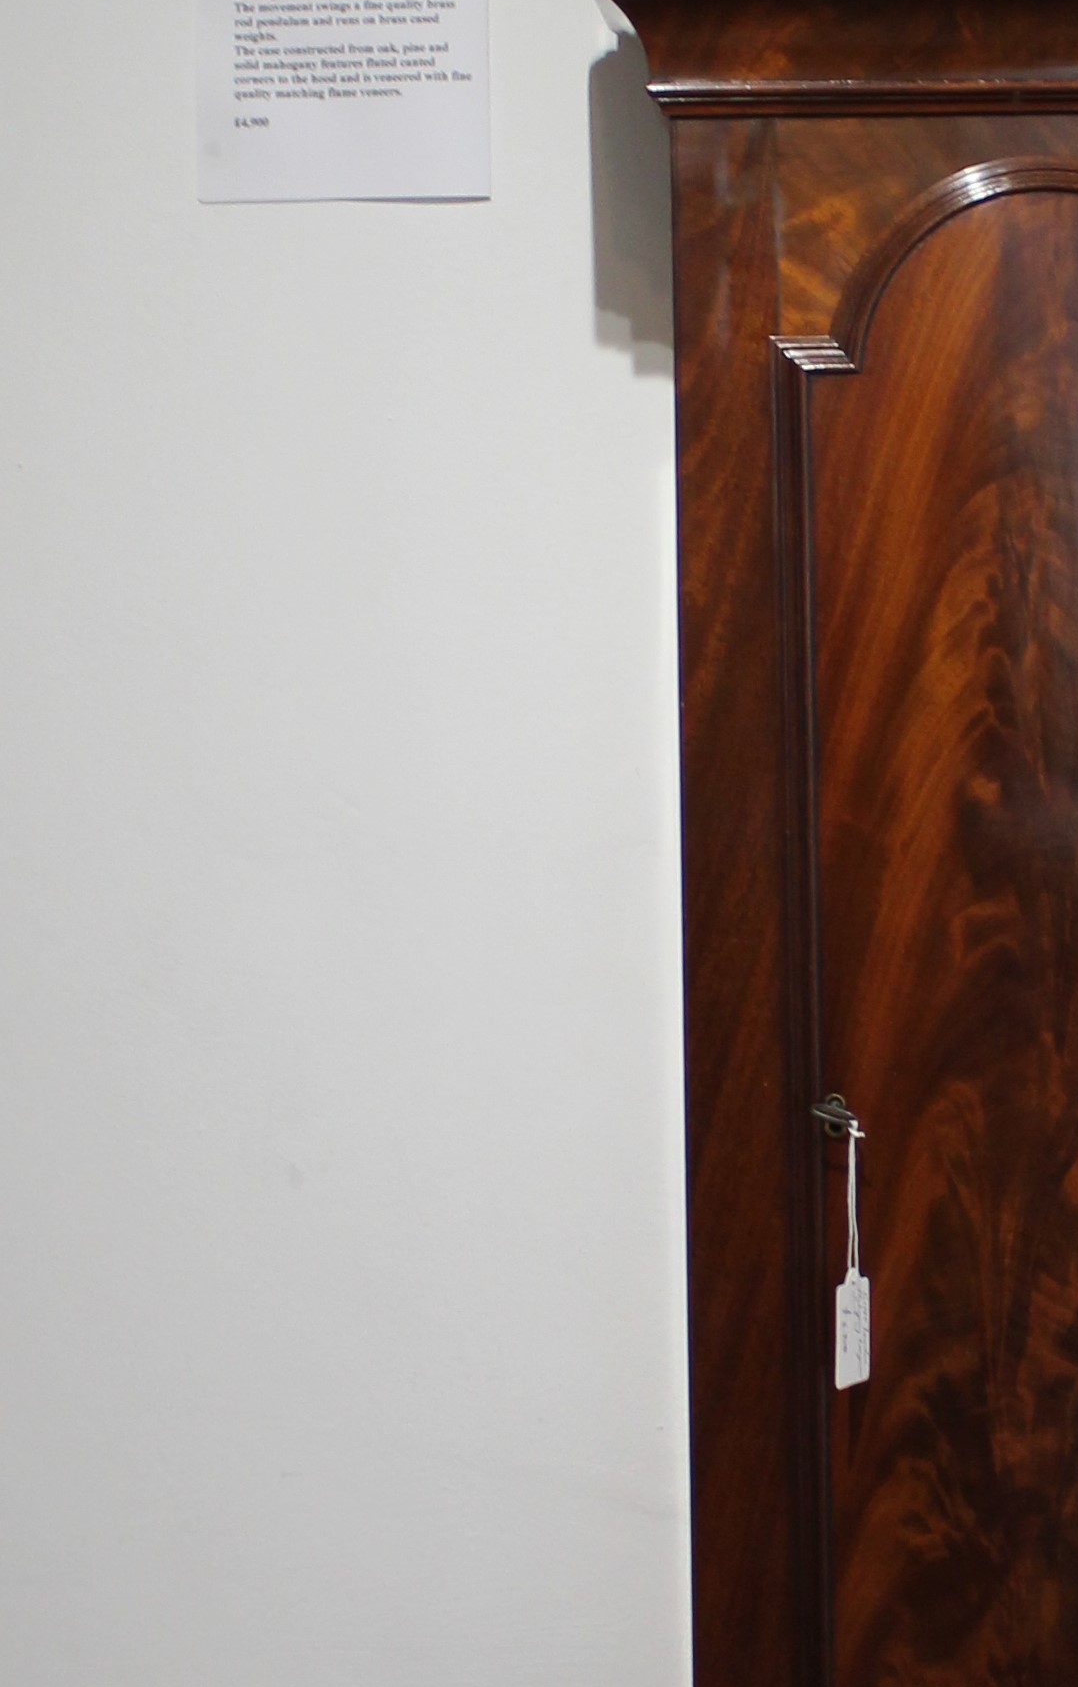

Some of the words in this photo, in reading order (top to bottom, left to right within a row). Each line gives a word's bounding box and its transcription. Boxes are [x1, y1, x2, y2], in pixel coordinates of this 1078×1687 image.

[233, 1, 256, 12] The
[258, 2, 313, 12] movement
[315, 1, 351, 13] swings
[363, 0, 384, 10] fine
[386, 0, 422, 12] quality
[426, 0, 456, 10] brass
[234, 16, 254, 26] rod
[256, 16, 310, 28] pendulum
[312, 15, 333, 25] and
[336, 16, 360, 25] runs
[362, 16, 376, 24] on
[378, 14, 407, 24] brass
[409, 13, 440, 24] cased
[233, 45, 256, 56] The
[258, 47, 281, 56] case
[283, 43, 345, 55] constructed
[348, 43, 374, 54] from
[402, 43, 426, 56] pine
[428, 41, 449, 53] and
[233, 60, 260, 70] solid
[262, 59, 317, 71] mahogany
[320, 58, 363, 69] features
[365, 57, 397, 68] fluted
[399, 56, 436, 68] canted
[233, 75, 275, 85] corners
[291, 74, 309, 84] the
[311, 73, 337, 83] hood
[339, 73, 360, 83] and
[373, 71, 421, 82] veneered
[424, 71, 449, 81] with
[451, 70, 473, 81] fine
[233, 89, 271, 101] quality
[275, 88, 326, 100] matching
[328, 87, 358, 97] flame
